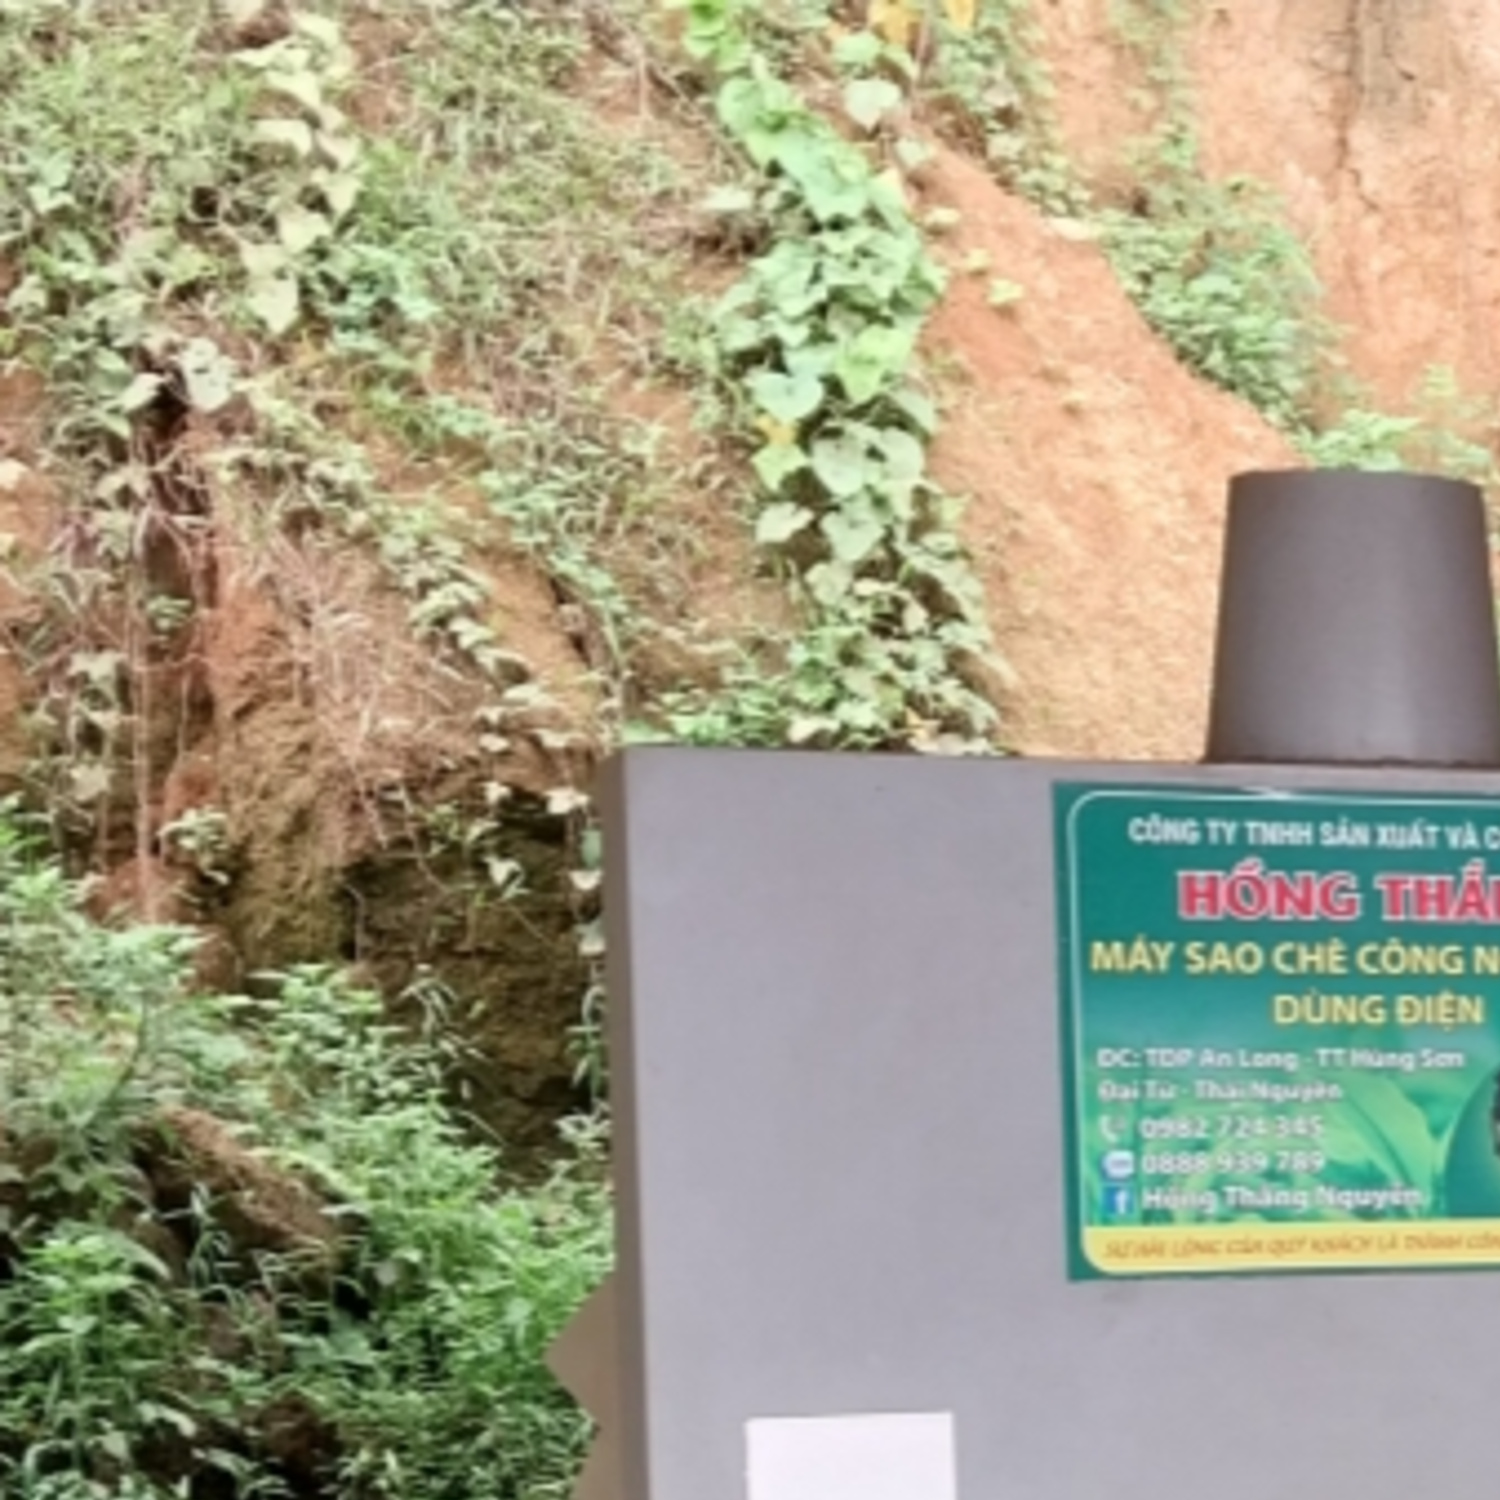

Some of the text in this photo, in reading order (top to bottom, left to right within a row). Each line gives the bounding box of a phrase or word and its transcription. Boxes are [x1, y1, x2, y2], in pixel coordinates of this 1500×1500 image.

[1127, 812, 1200, 845] CÔNG
[1206, 819, 1239, 846] TY
[1244, 820, 1314, 846] TNHH
[1375, 816, 1441, 849] XUẤT
[1444, 820, 1481, 850] VÀ
[1091, 933, 1176, 973] MÁY
[1185, 940, 1264, 975] SAO
[1356, 936, 1465, 976] CÔNG
[1273, 986, 1485, 1032] DÙNG ĐIỆN
[1239, 1048, 1299, 1073] Long
[1315, 1048, 1348, 1068] TT
